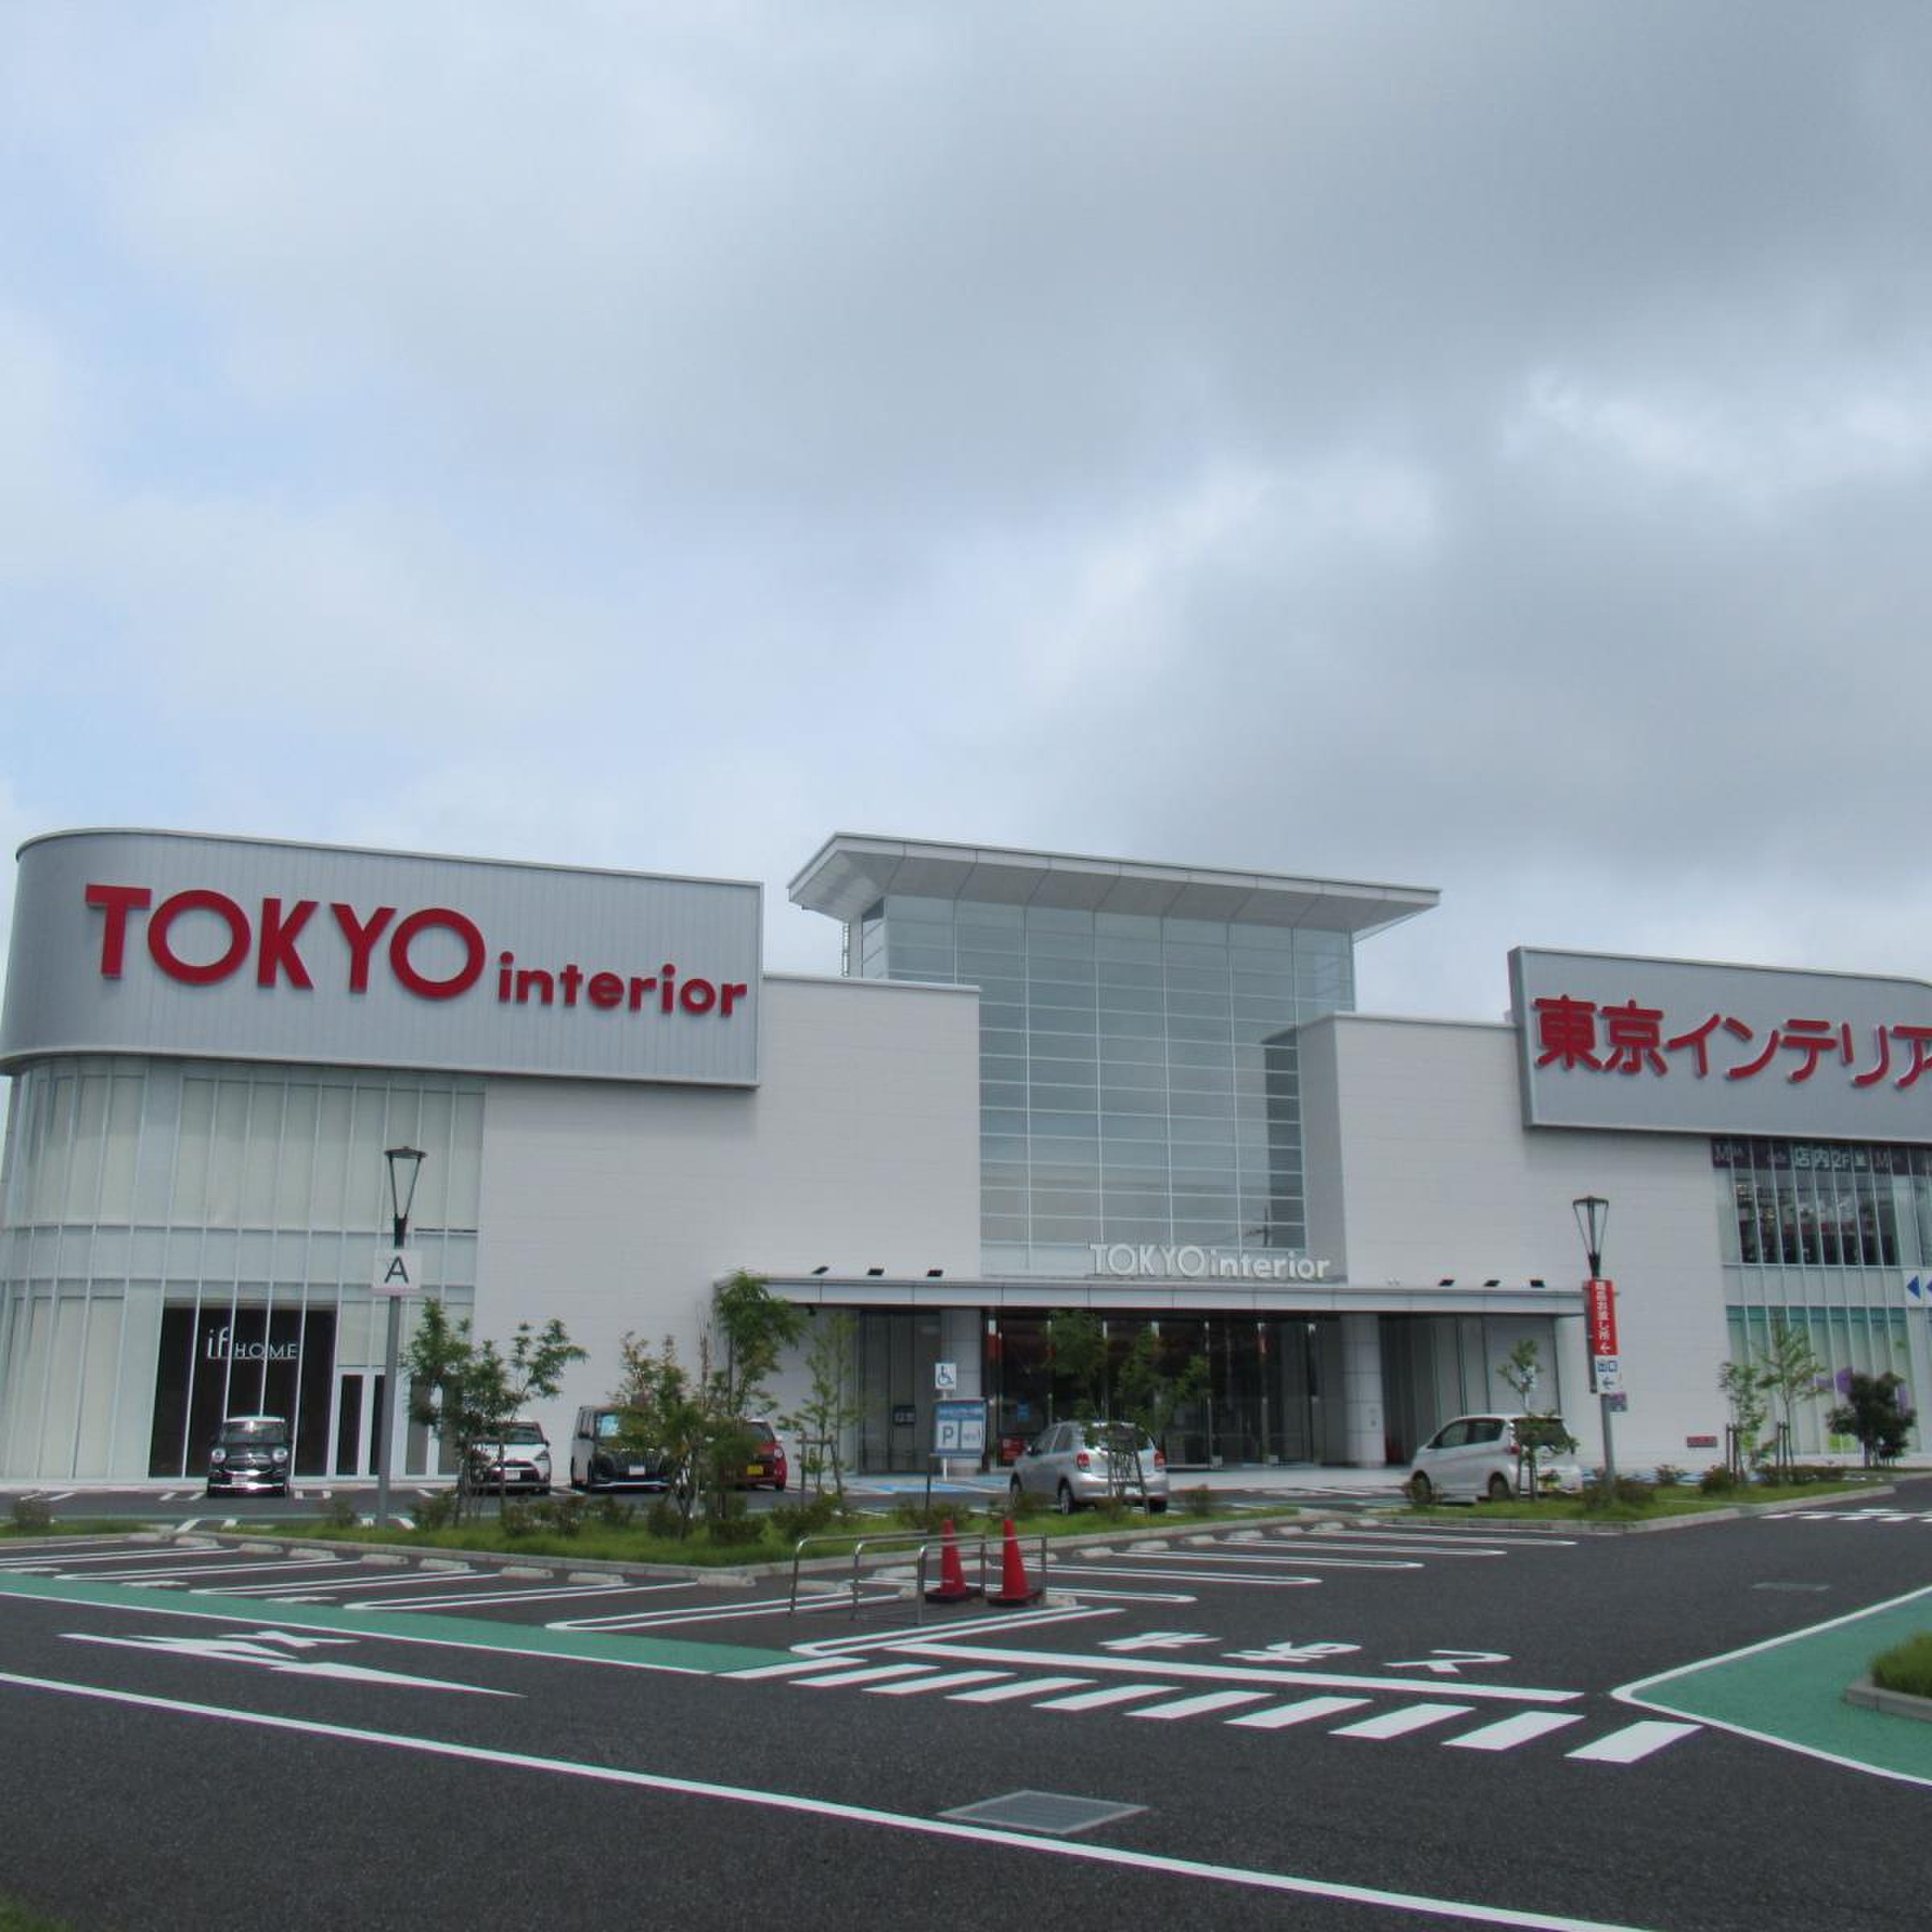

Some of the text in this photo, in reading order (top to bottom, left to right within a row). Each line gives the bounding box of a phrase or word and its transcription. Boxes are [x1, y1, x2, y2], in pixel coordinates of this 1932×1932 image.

[85, 884, 748, 1018] TOKYO interior
[1533, 994, 1932, 1088] 東京インテリア
[384, 1256, 409, 1284] A
[1090, 1244, 1330, 1280] TOKYO interior
[234, 1342, 297, 1360] HOME
[1096, 1631, 1512, 1675] とまれ
